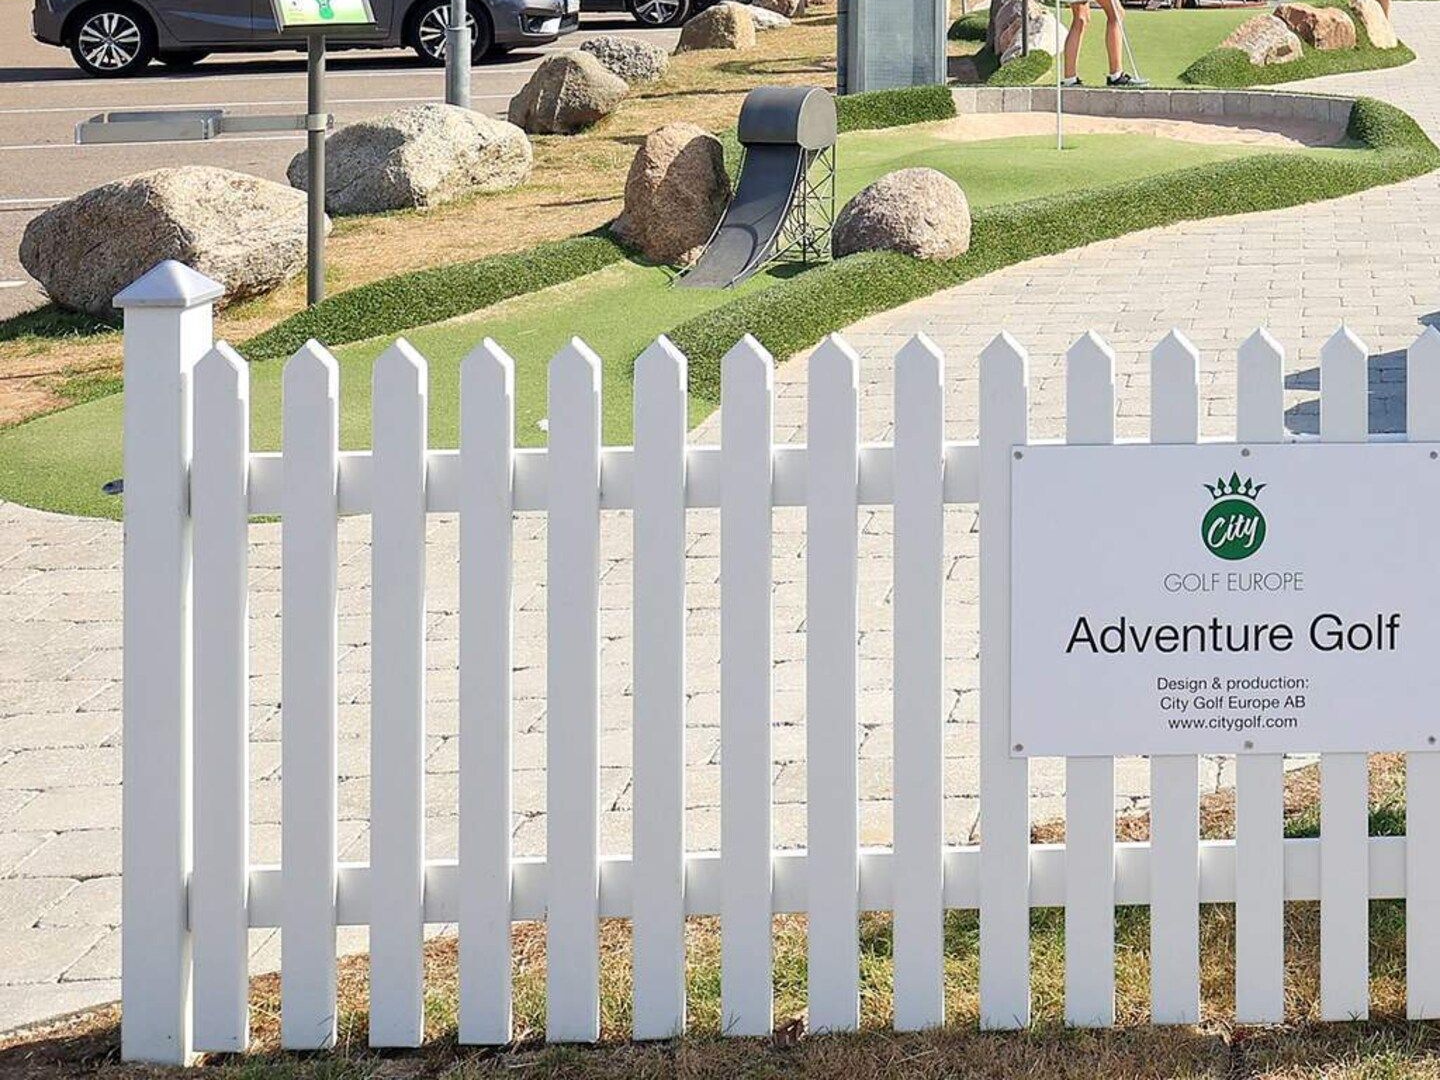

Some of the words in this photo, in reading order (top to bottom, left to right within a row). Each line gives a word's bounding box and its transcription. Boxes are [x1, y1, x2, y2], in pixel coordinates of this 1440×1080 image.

[1207, 513, 1259, 548] City
[1163, 572, 1221, 593] GOLF
[1226, 571, 1304, 592] EUROPE
[1066, 616, 1294, 653] Adventure
[1309, 613, 1401, 652] Golf
[1156, 676, 1207, 693] Design
[1211, 676, 1223, 690] &
[1226, 675, 1310, 692] production:
[1159, 695, 1189, 713] City
[1193, 695, 1224, 710] Golf
[1228, 694, 1280, 711] Europe
[1283, 694, 1306, 709] AB
[1168, 715, 1298, 732] www.citygolf.com
